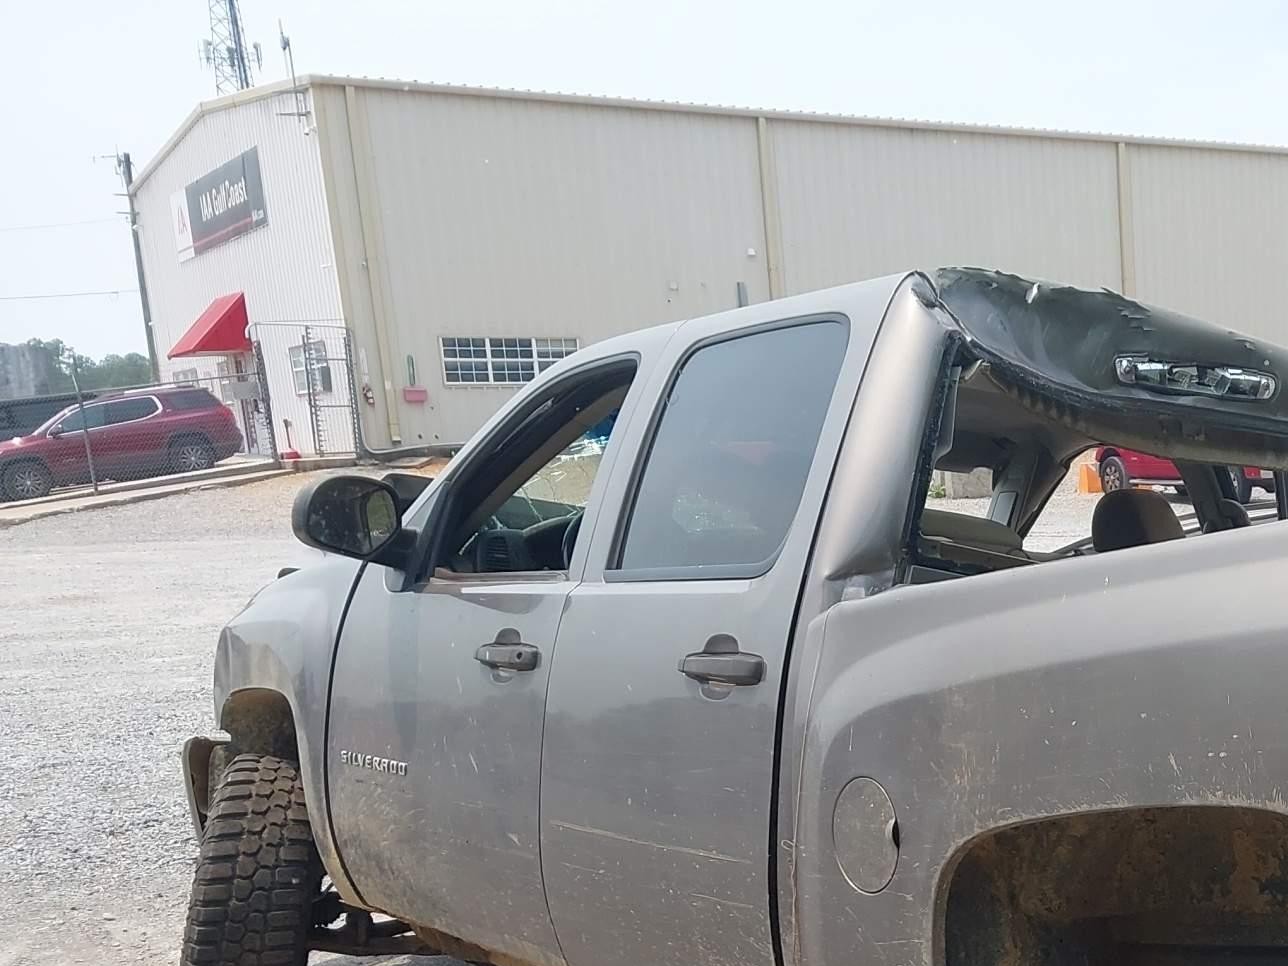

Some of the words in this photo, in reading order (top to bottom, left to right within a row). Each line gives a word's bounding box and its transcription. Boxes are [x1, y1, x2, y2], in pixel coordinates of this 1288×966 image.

[199, 191, 215, 222] IAA
[225, 176, 248, 208] Coast
[340, 750, 409, 776] SILVERADO
